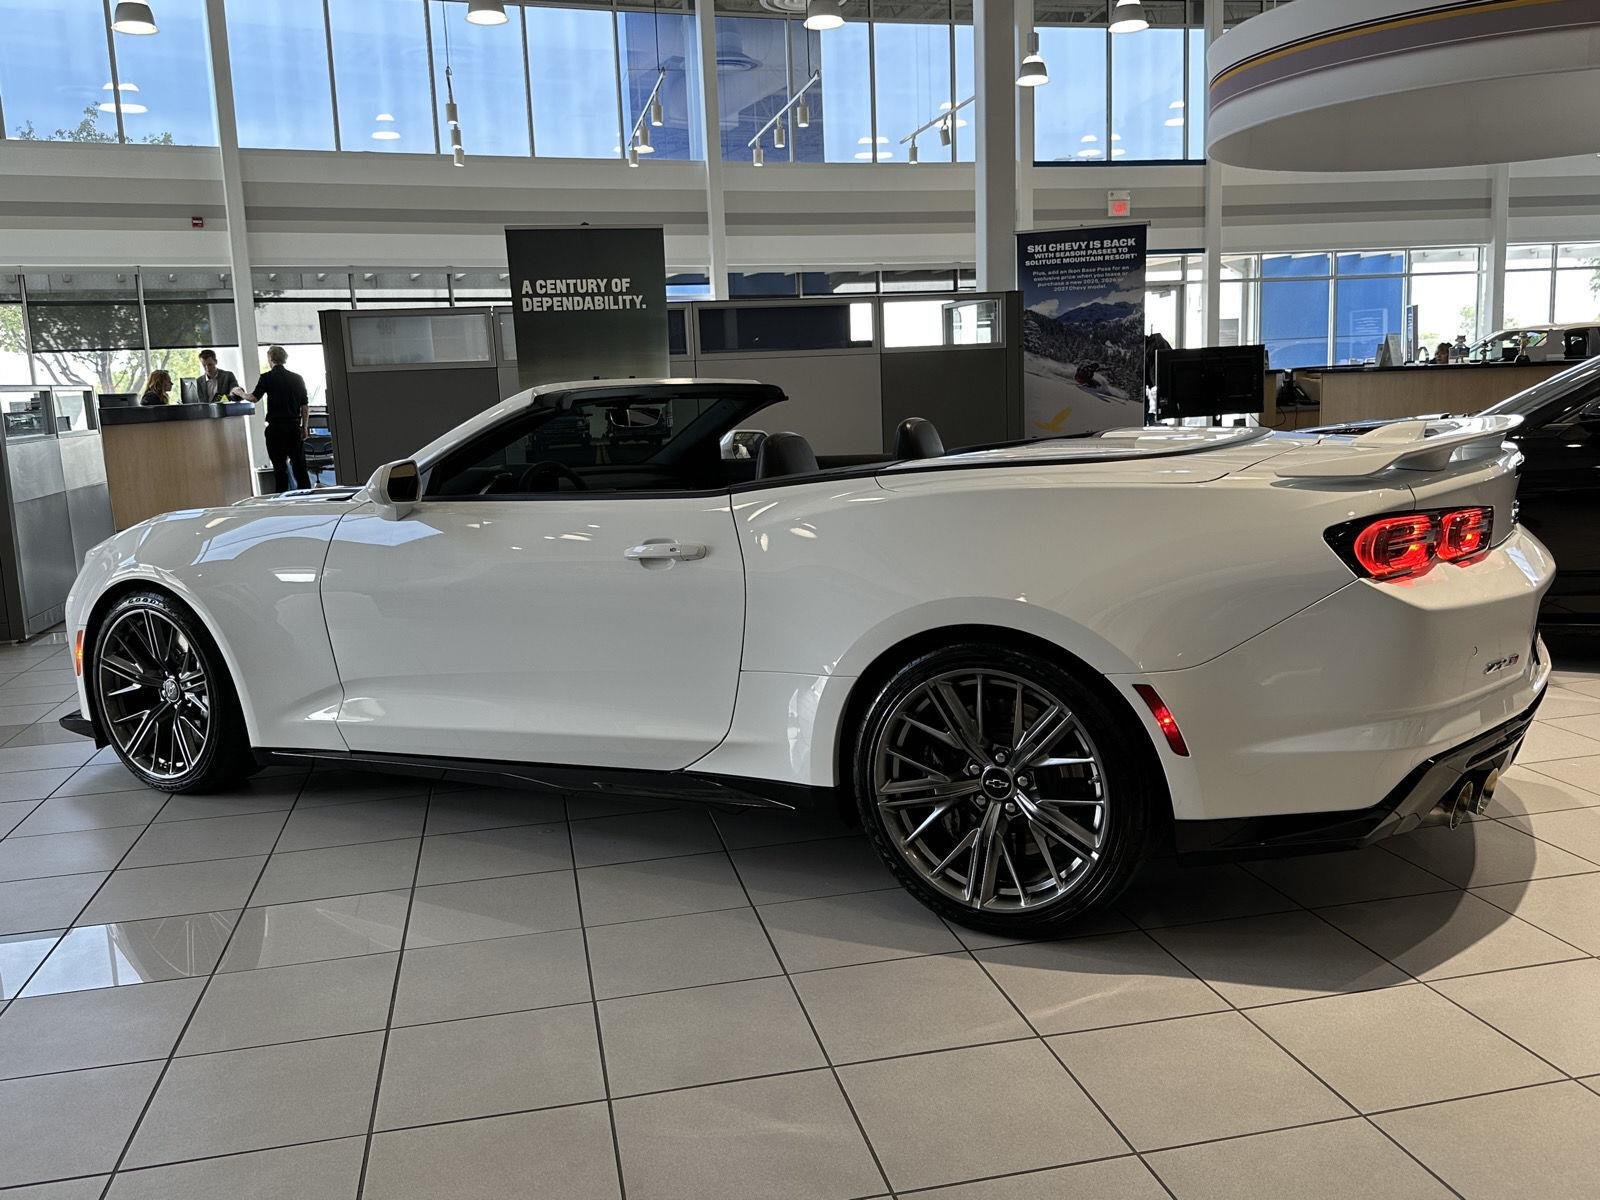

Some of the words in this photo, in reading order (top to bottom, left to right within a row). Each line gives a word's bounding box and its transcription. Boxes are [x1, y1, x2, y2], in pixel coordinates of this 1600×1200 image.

[1027, 244, 1046, 253] SKI
[1049, 242, 1088, 251] CHEVY
[1089, 240, 1101, 249] IS
[1103, 238, 1136, 248] BACK
[1025, 258, 1061, 266] SOLITUDE
[1063, 255, 1104, 264] MOUNTAIN
[1055, 250, 1086, 258] SEASON
[521, 280, 533, 294] A
[536, 278, 608, 294] CENTURY
[611, 278, 630, 293] OF
[522, 295, 647, 312] DEPENDABILITY.
